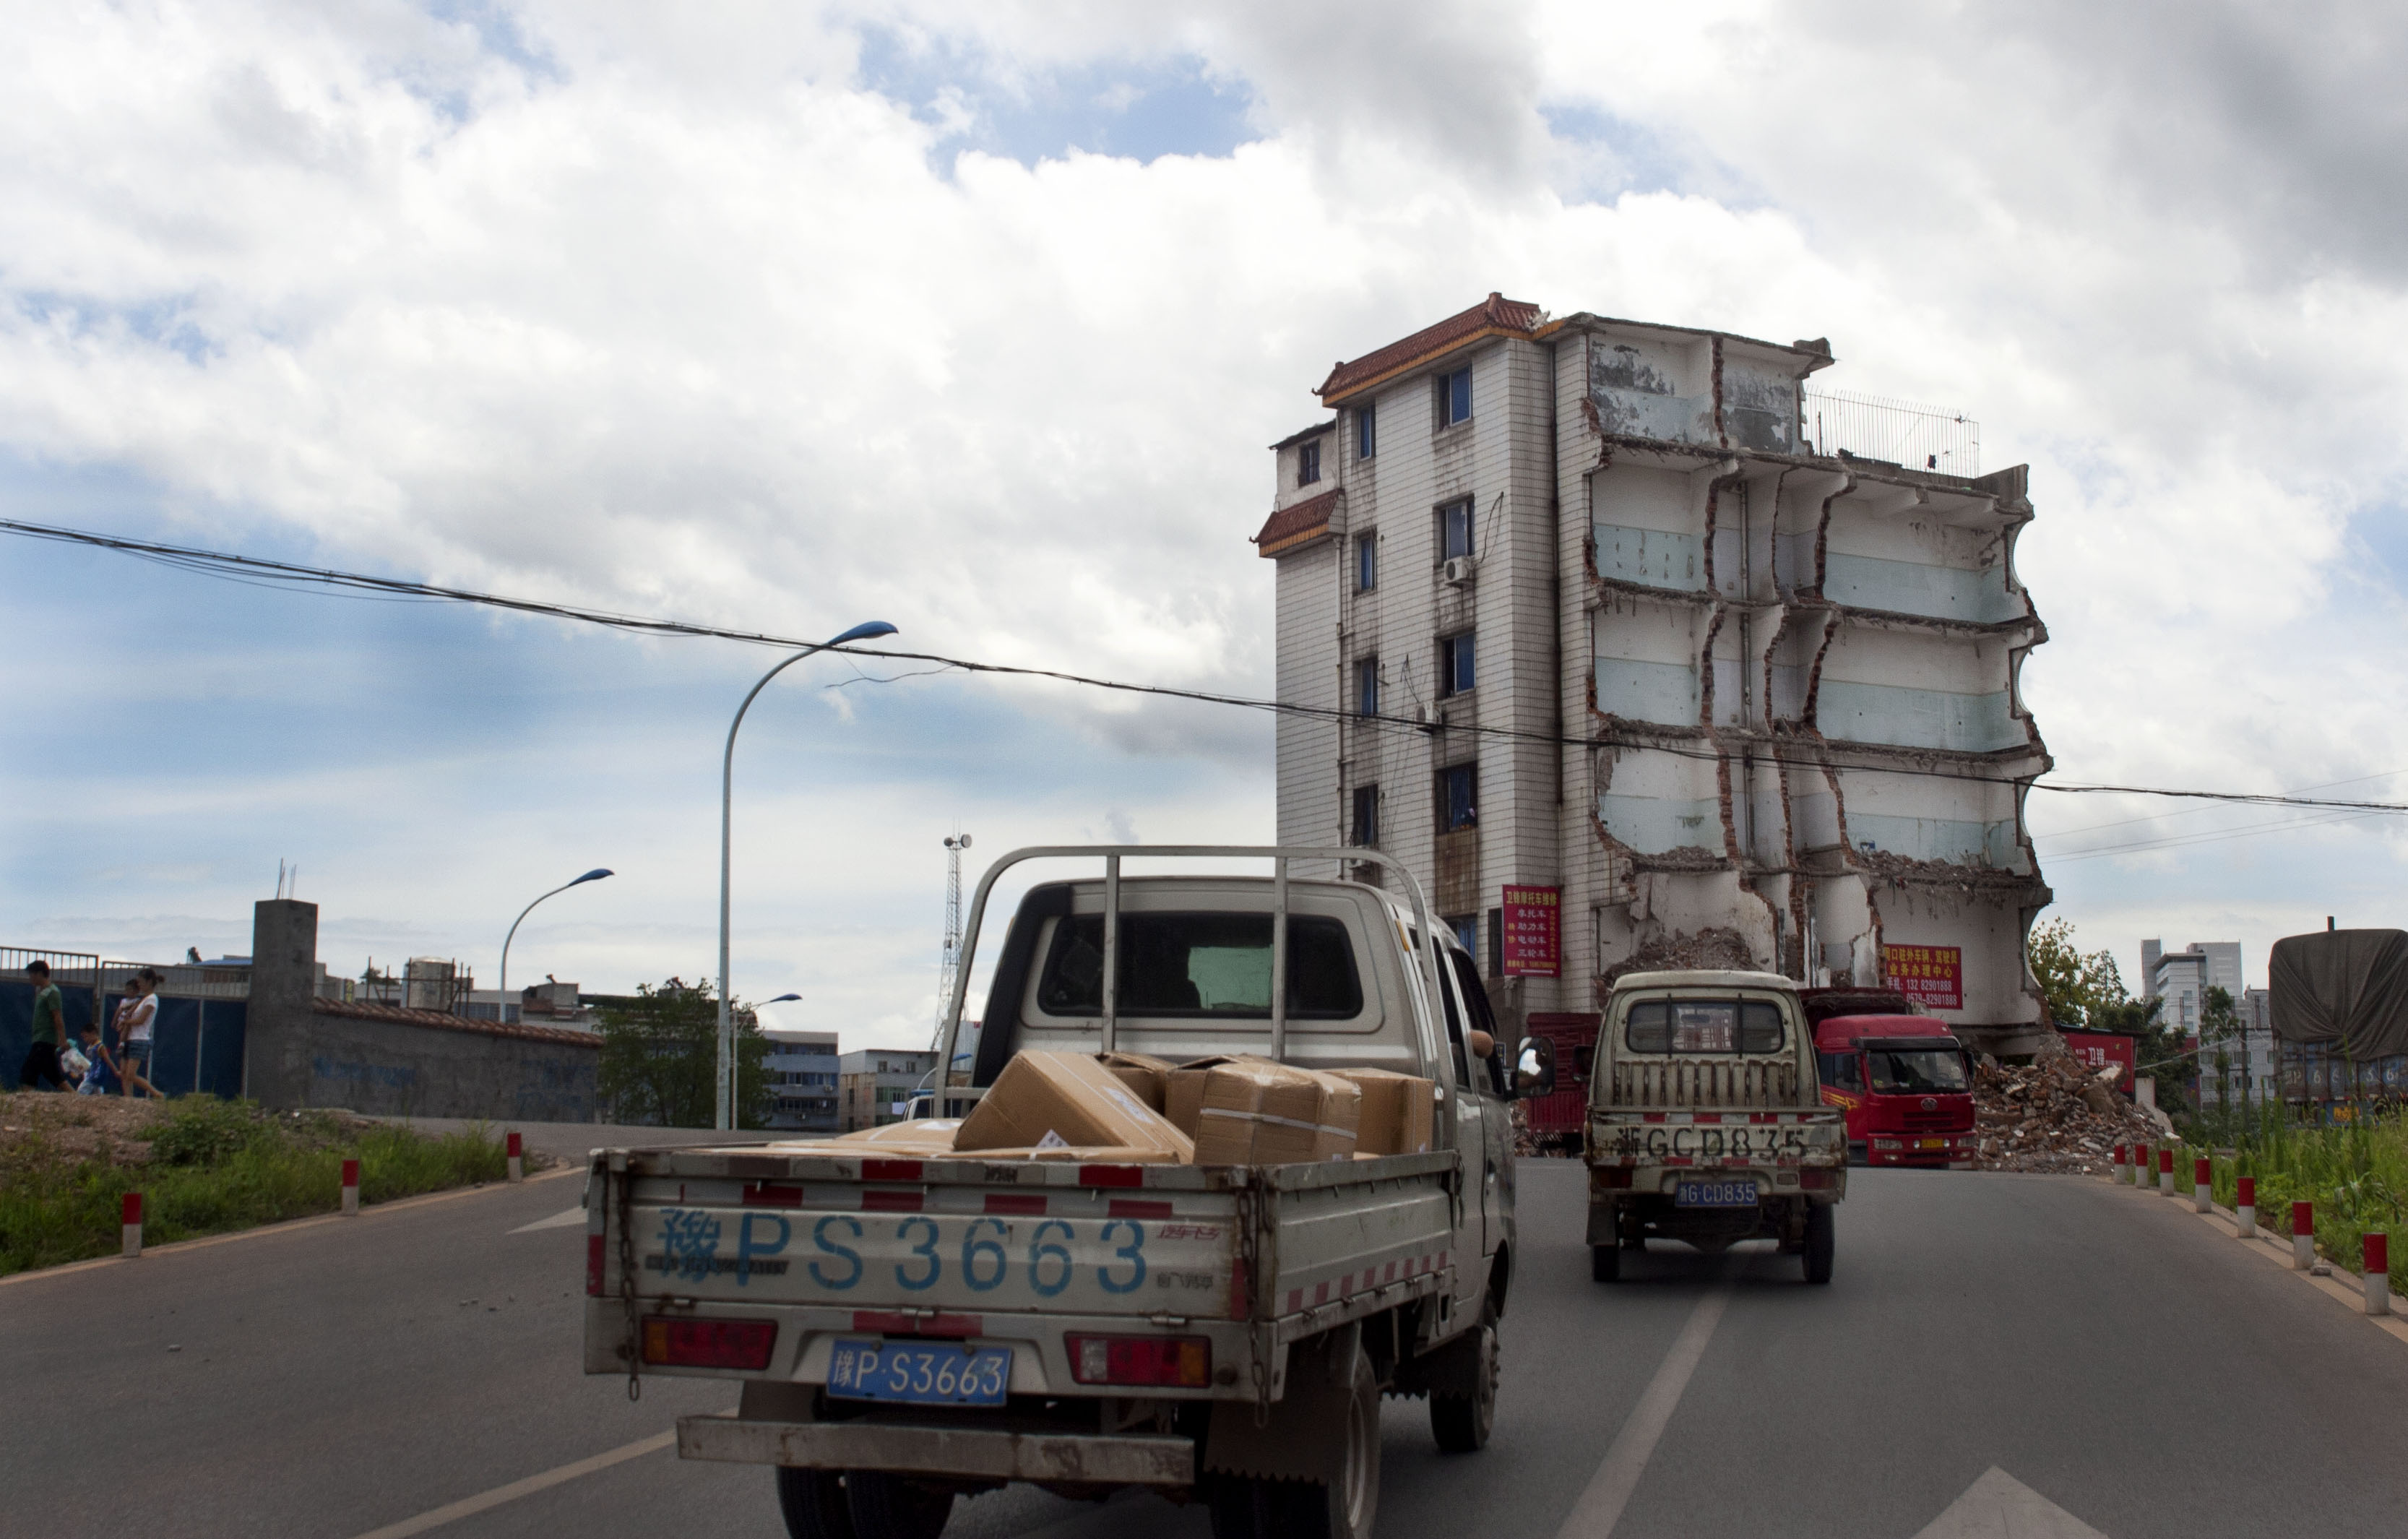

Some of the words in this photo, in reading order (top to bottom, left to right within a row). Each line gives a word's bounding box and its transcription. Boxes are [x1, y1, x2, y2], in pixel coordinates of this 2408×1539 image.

[1518, 923, 1546, 931] 助力车
[1518, 936, 1546, 945] 电动车
[1518, 949, 1546, 958] 三轮车
[1889, 963, 1952, 978] 业务办理中心
[1907, 979, 1918, 991] 132
[656, 1207, 1147, 1298] 豫PS3663
